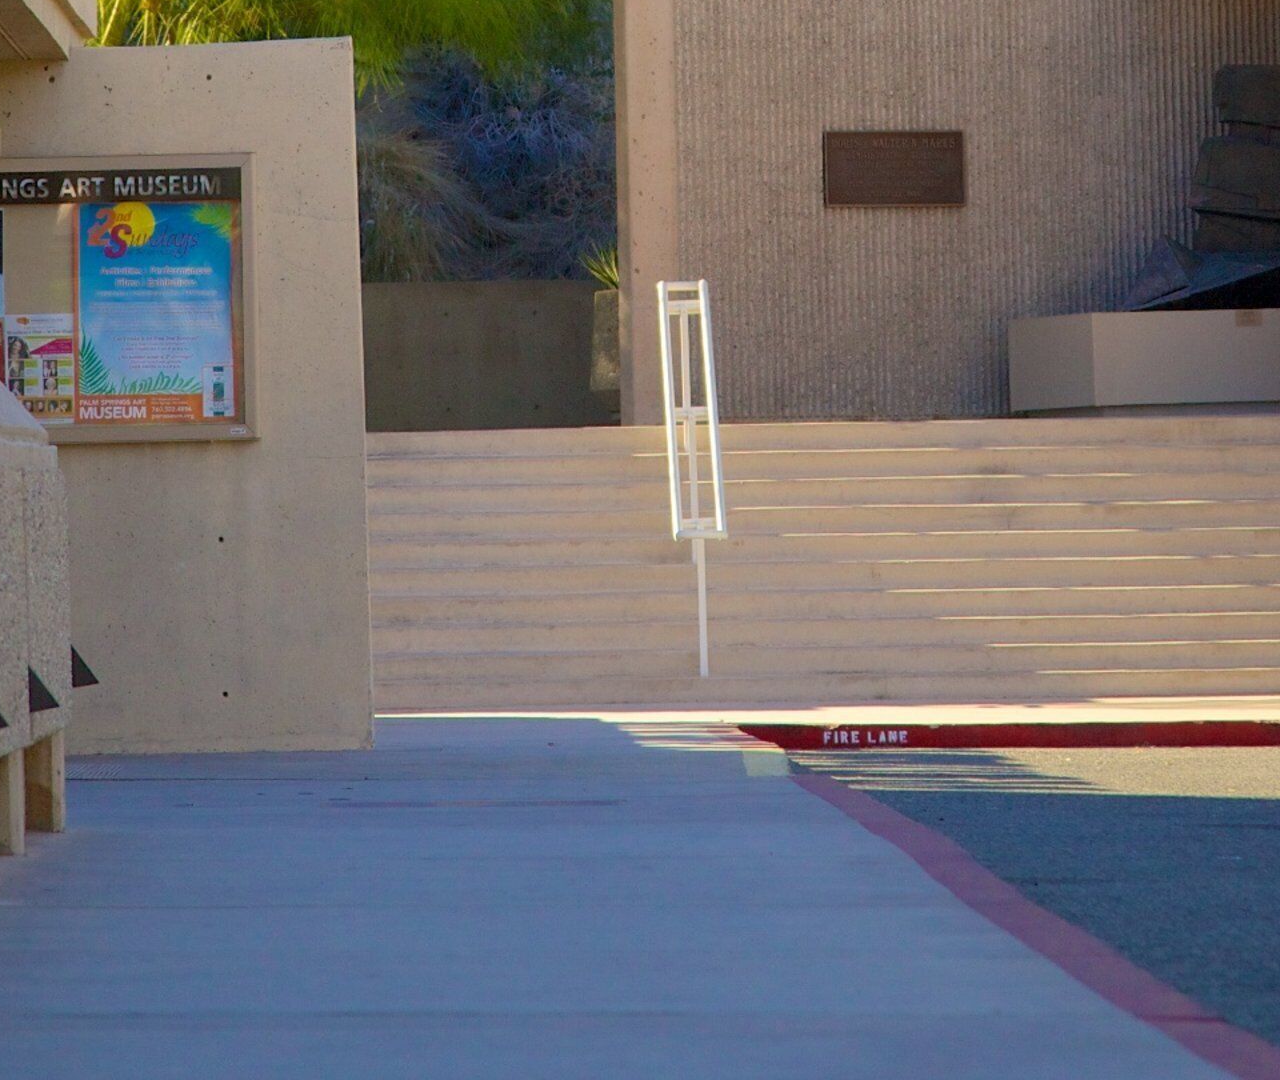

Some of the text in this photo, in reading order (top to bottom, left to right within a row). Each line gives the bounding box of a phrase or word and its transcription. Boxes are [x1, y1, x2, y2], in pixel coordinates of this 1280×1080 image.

[59, 177, 105, 198] ART
[114, 175, 220, 197] MUSEUM
[87, 207, 132, 246] 2nd
[104, 224, 200, 259] Sundays
[132, 398, 147, 406] ART
[80, 406, 147, 419] MUSEUM
[823, 730, 908, 744] FIRE LANE
